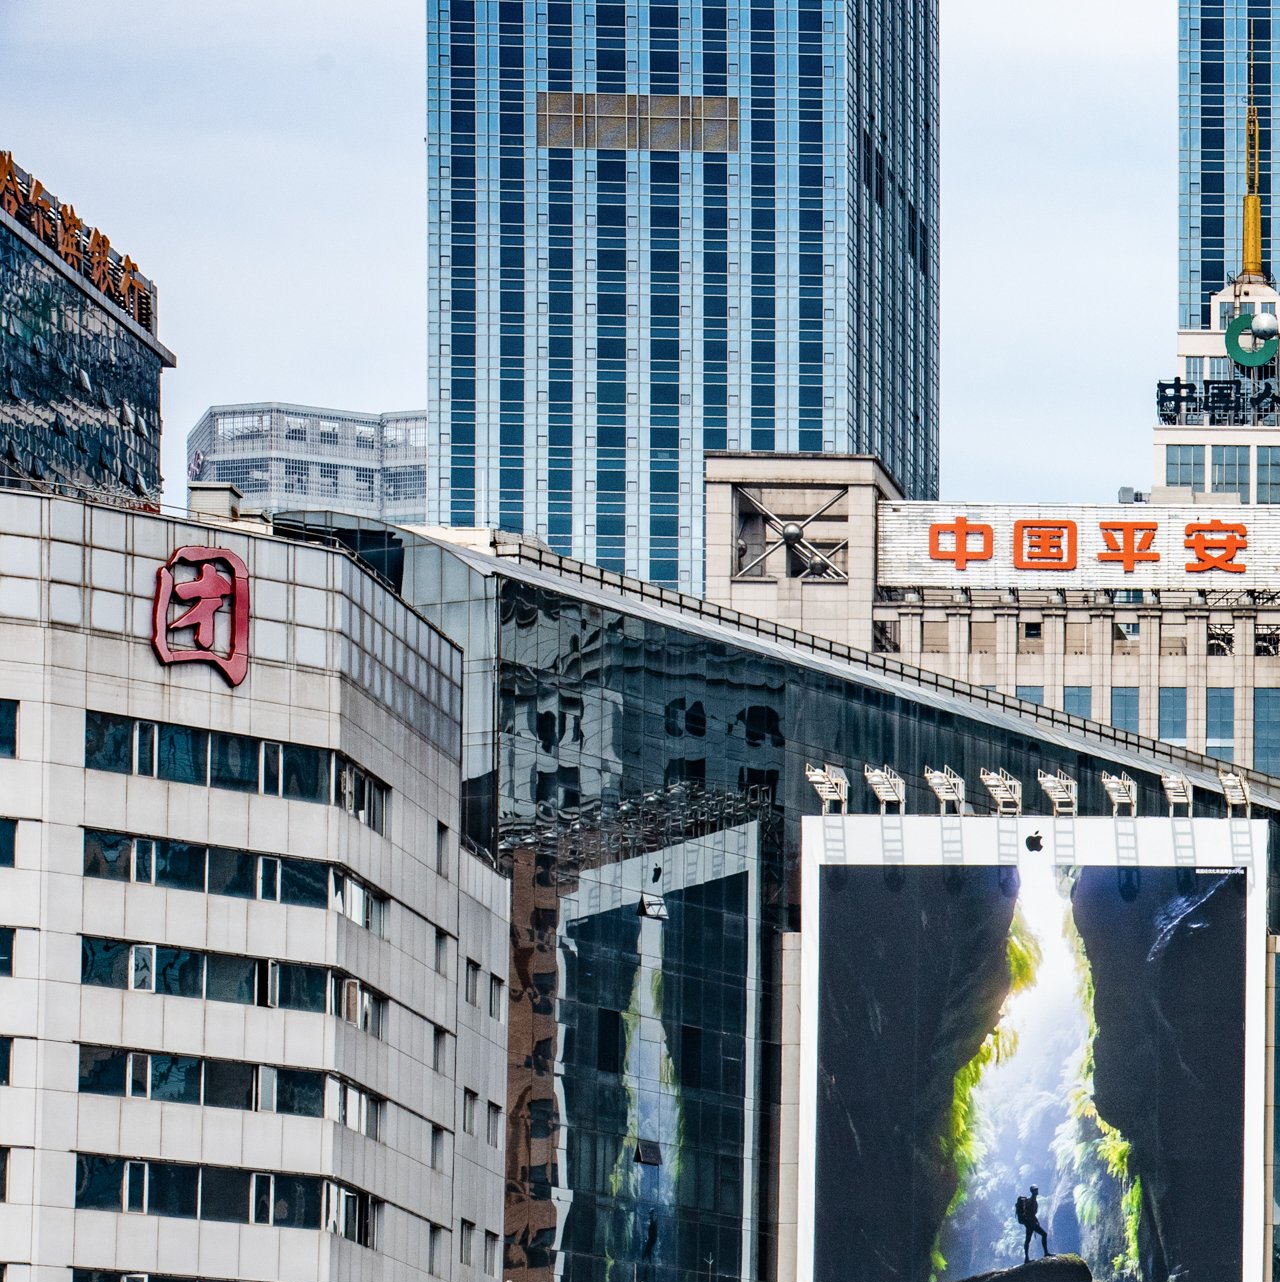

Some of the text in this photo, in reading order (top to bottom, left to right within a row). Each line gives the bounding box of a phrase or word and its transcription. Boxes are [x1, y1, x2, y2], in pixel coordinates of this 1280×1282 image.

[928, 517, 1249, 574] 中国平安
[152, 546, 250, 687] 团
